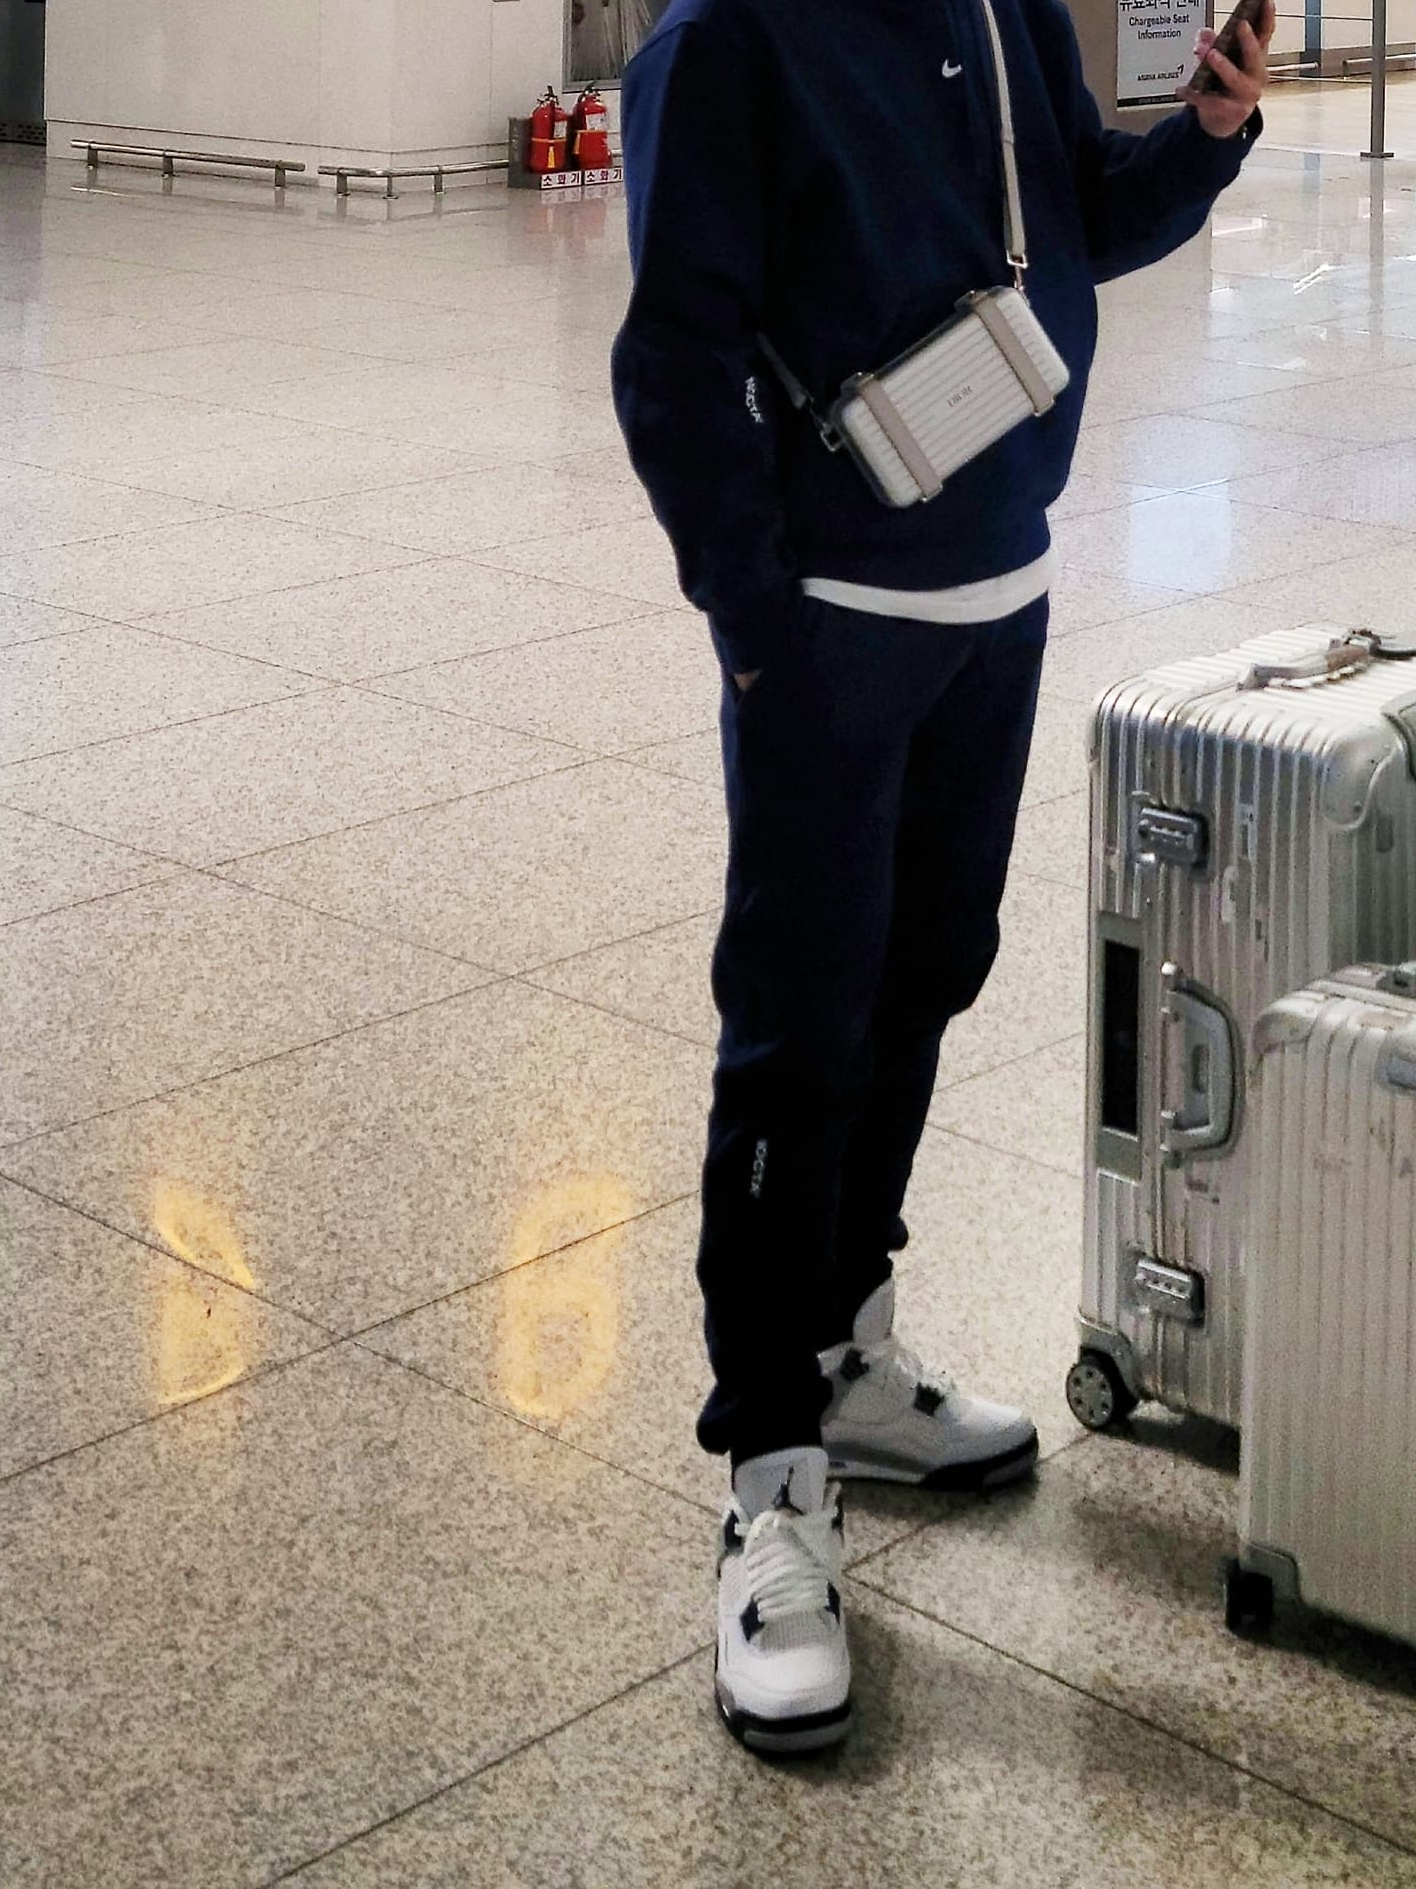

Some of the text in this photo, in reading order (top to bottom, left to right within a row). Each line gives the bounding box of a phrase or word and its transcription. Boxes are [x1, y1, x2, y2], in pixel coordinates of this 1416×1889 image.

[1128, 13, 1189, 28] Chargeable Seat
[1137, 28, 1181, 40] Information
